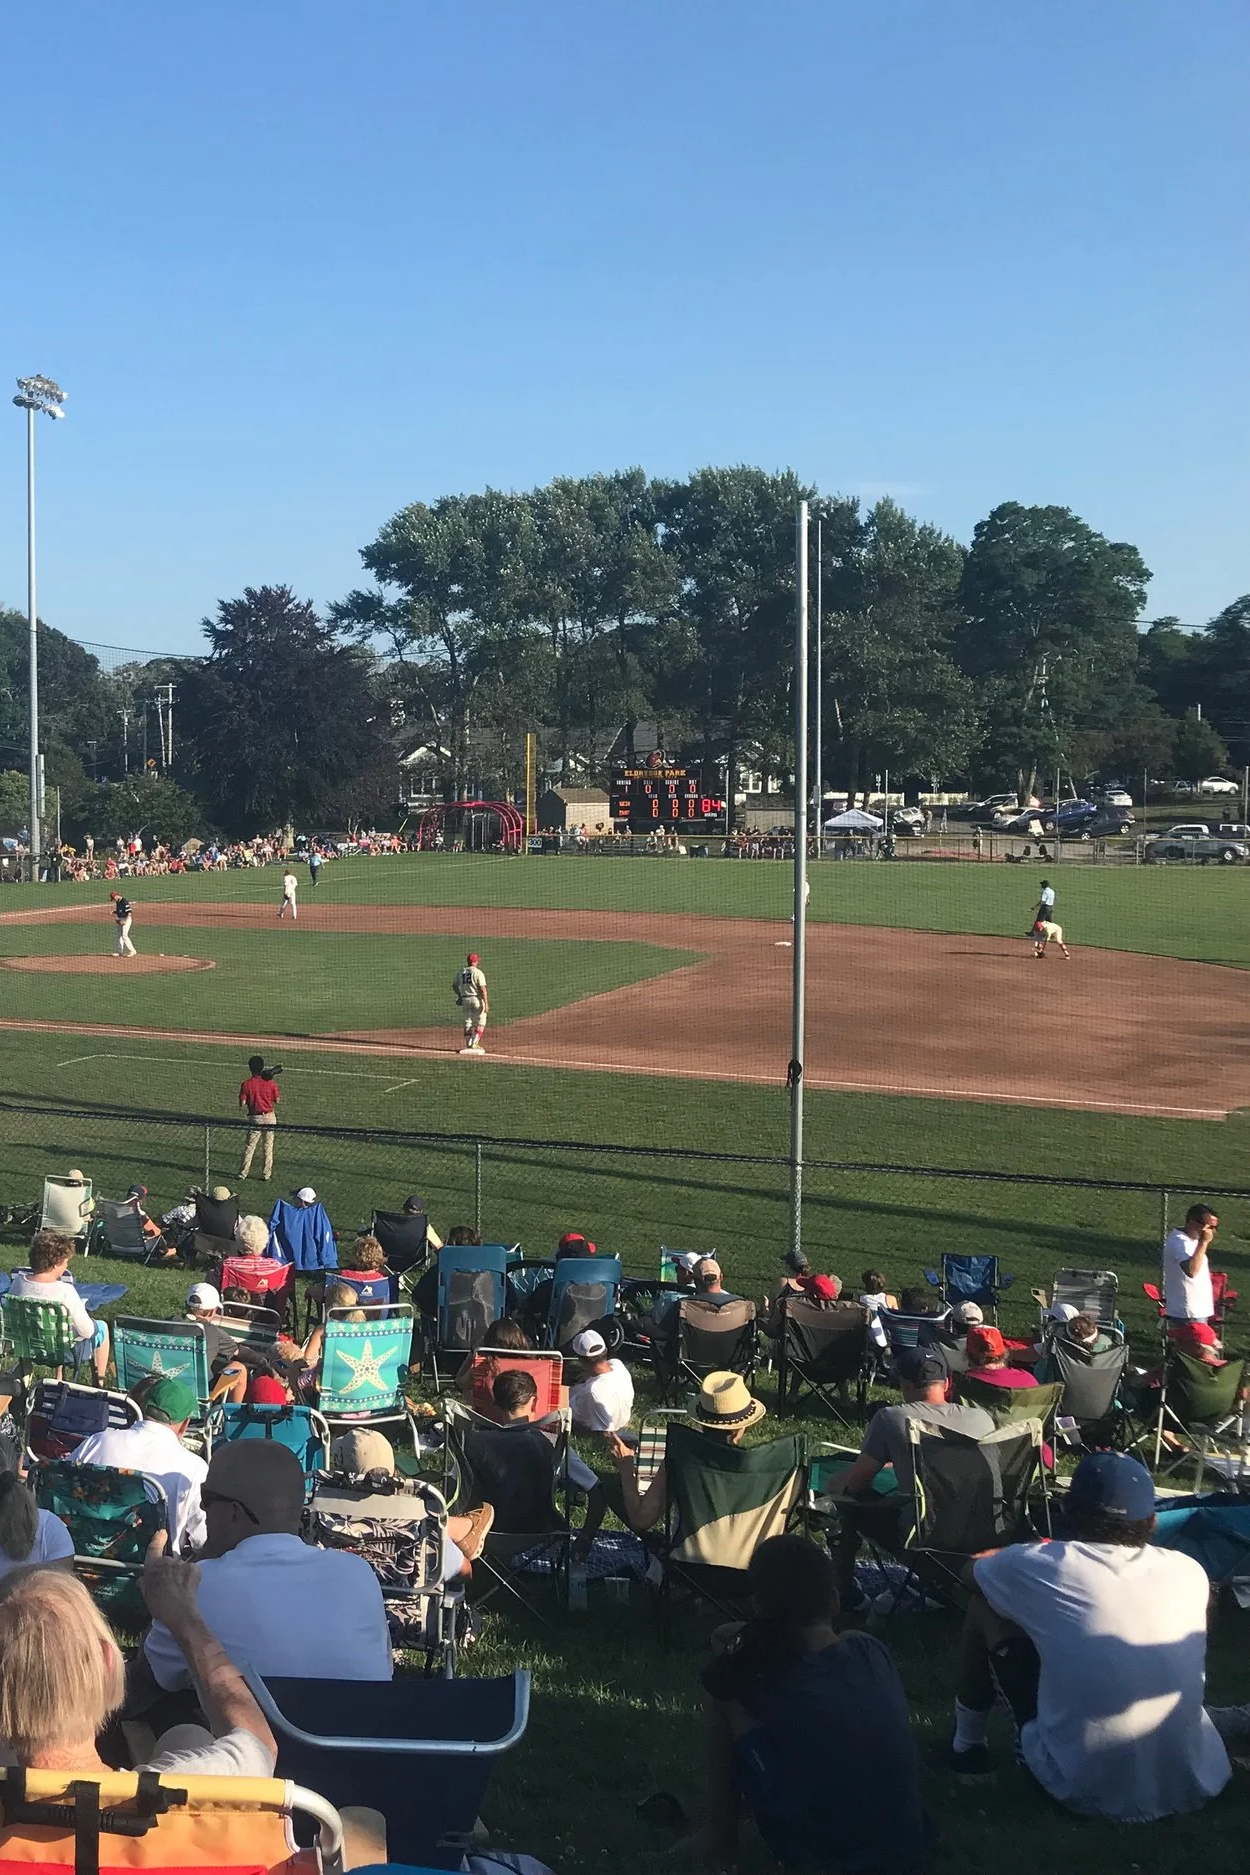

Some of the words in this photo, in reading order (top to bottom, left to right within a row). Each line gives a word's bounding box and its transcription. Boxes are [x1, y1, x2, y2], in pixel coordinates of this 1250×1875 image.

[645, 785, 652, 793] 0
[669, 785, 675, 793] 0
[690, 785, 696, 793] 0
[652, 799, 658, 808] 0
[672, 799, 678, 808] 0
[688, 799, 694, 808] 0
[702, 799, 721, 812] 84
[652, 809, 658, 817] 0
[672, 809, 678, 817] 0
[688, 809, 694, 817] 0
[529, 838, 542, 846] 300
[462, 972, 472, 985] 12
